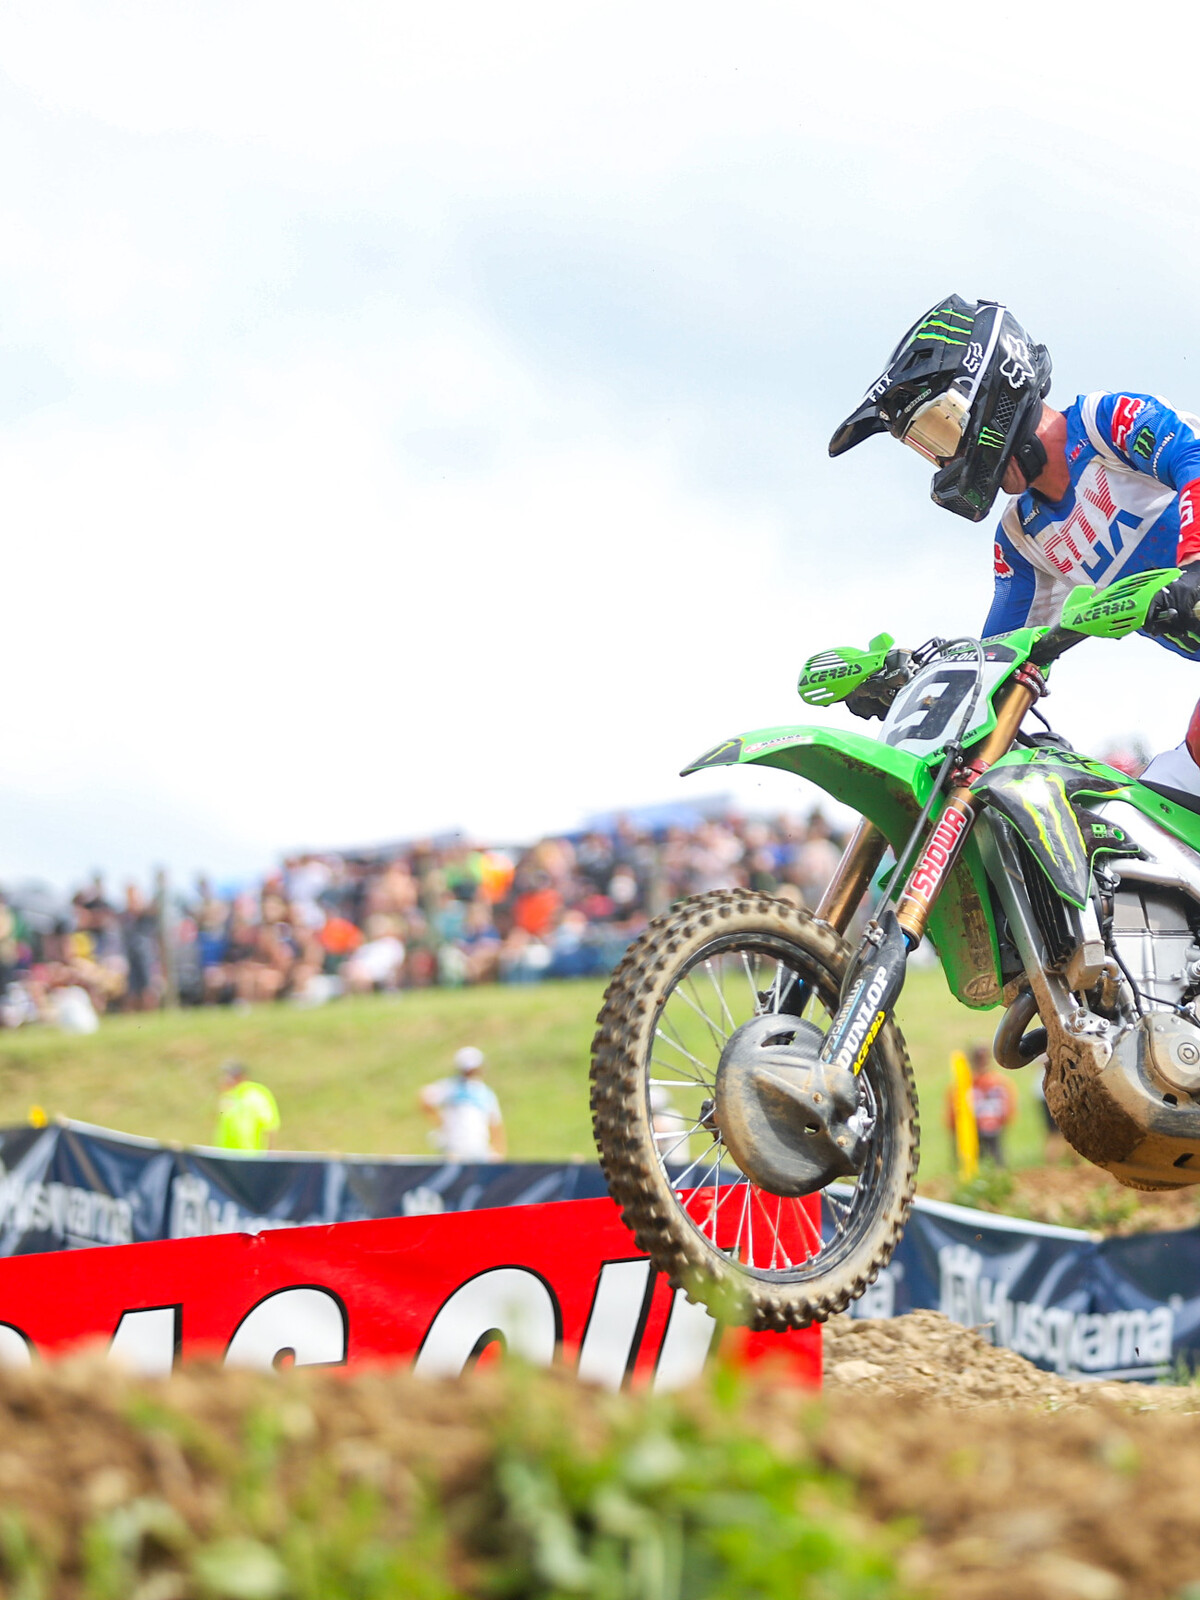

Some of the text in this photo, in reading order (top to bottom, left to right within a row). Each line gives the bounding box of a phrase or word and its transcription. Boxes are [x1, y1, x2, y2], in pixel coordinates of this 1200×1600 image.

[869, 373, 893, 402] FOX
[1072, 599, 1136, 626] ACERBIS
[799, 664, 863, 686] ACERBIS
[911, 805, 967, 899] SHOWA
[836, 966, 889, 1071] DUNLOP
